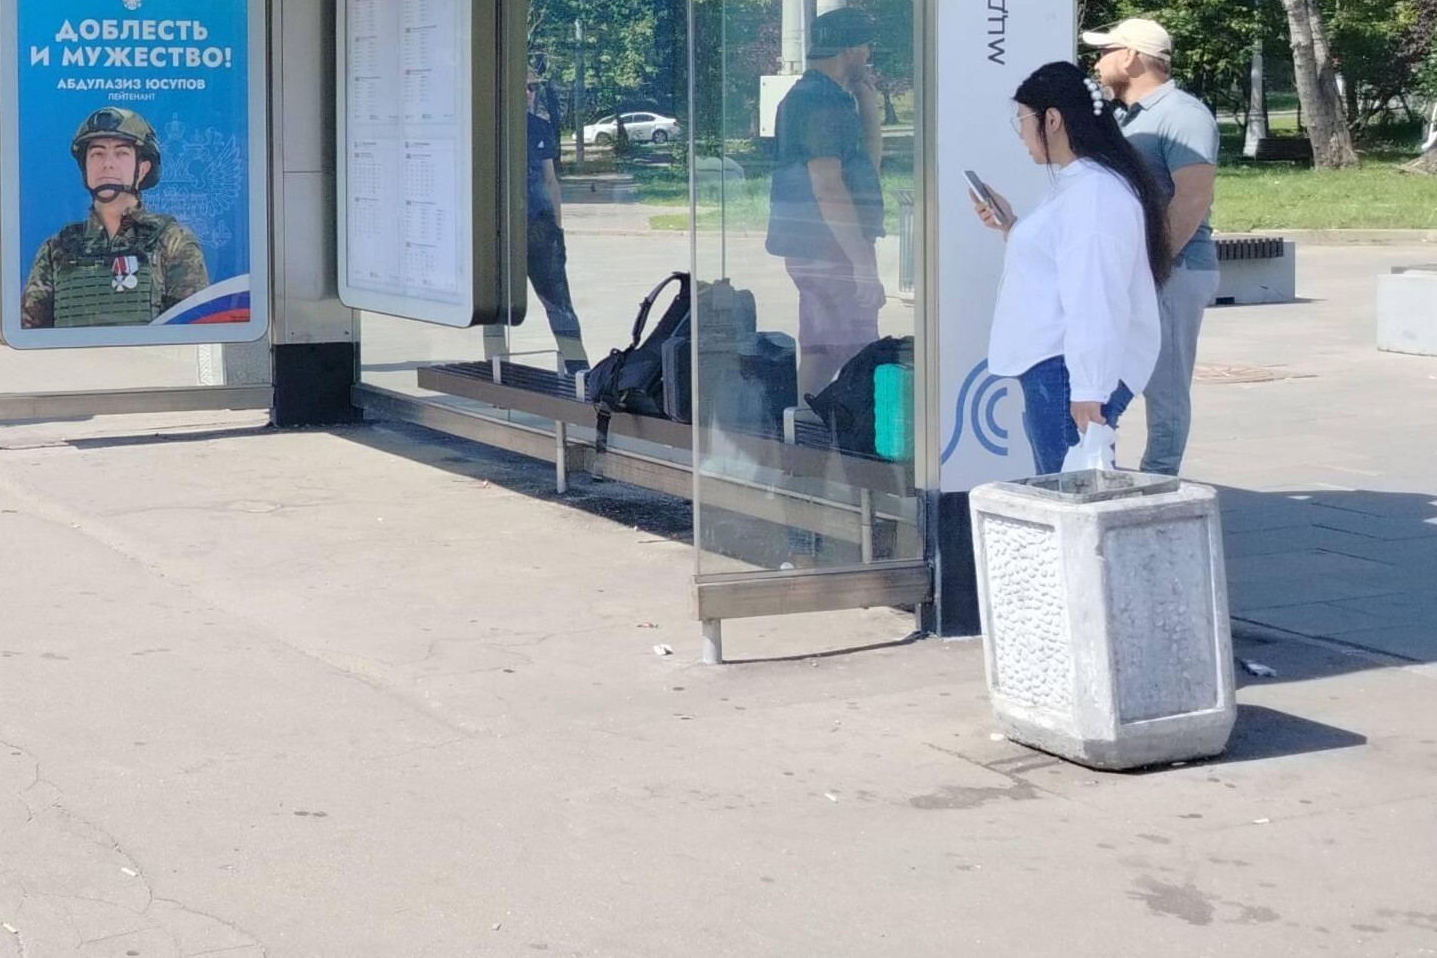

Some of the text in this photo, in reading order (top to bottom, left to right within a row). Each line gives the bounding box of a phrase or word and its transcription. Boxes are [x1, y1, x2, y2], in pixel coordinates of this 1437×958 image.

[55, 19, 208, 42] ДОБЛЕСТЬ
[30, 46, 232, 68] И МУЖЕСТВО!
[56, 79, 206, 90] АБДУЛАЗИЗ ЮСУПОВ
[108, 91, 156, 101] ЛЕЙТЕНАНТ
